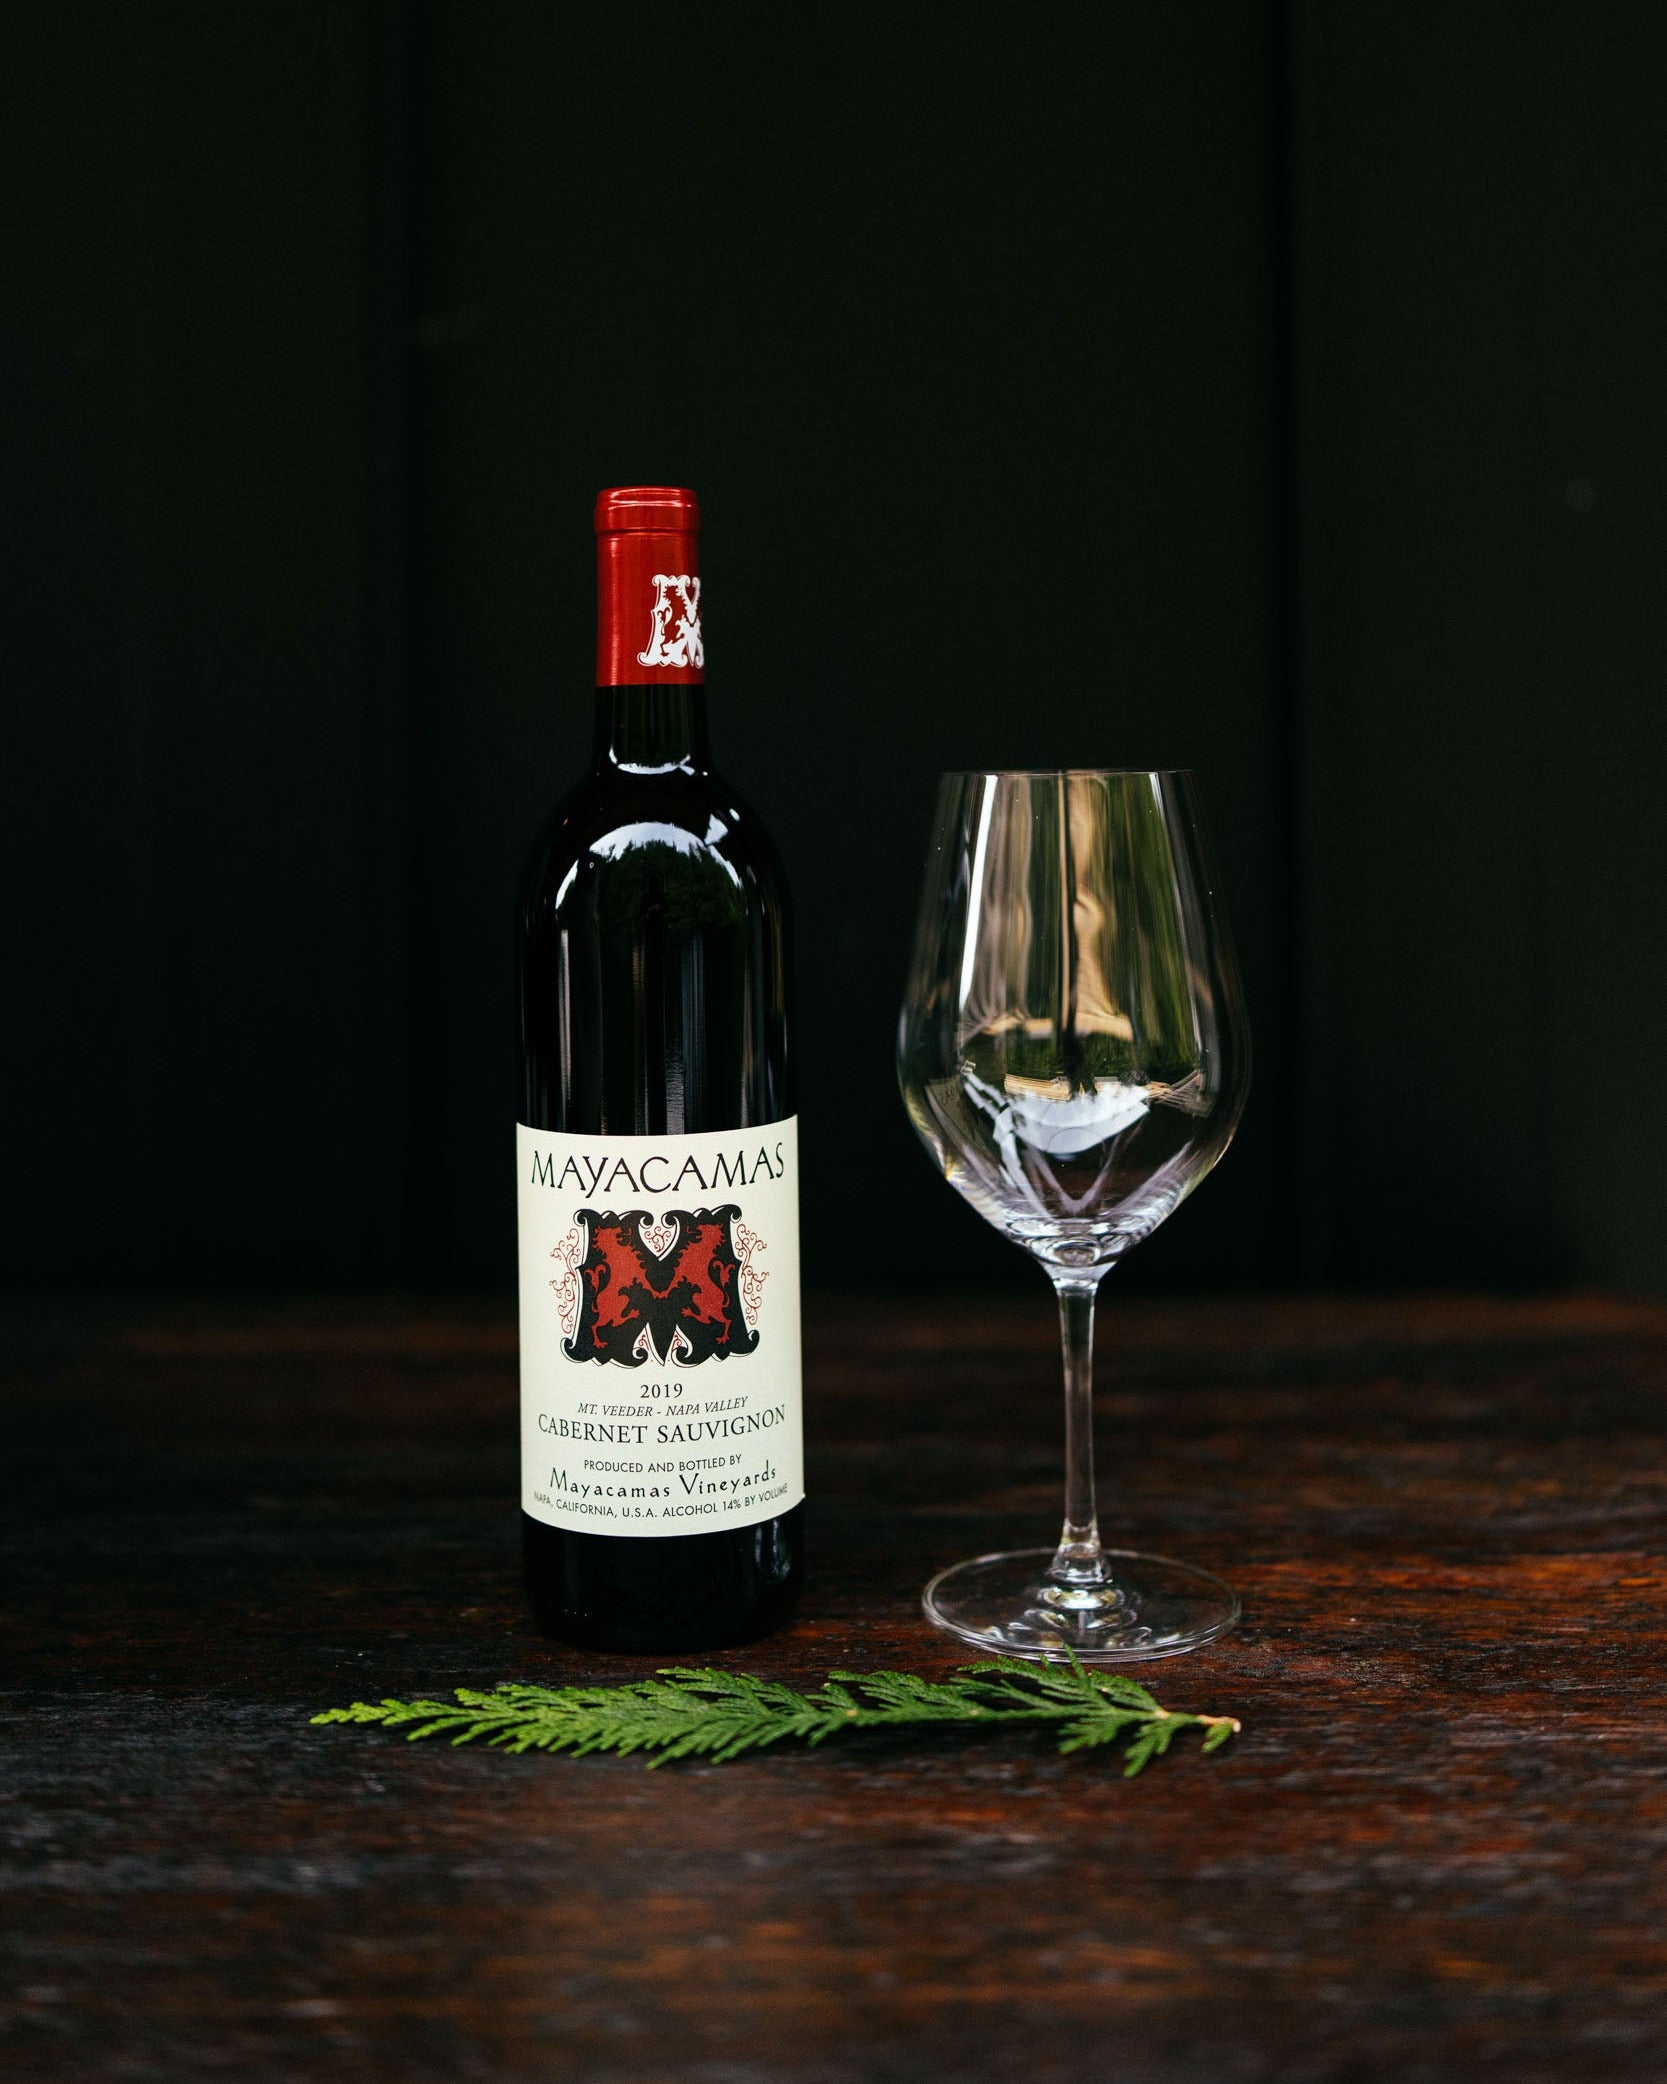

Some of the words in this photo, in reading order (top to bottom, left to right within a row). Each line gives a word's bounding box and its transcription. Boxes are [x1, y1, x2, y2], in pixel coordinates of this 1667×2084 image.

[531, 1142, 784, 1199] MAYACAMAS
[640, 1383, 683, 1398] 2019
[577, 1402, 598, 1415] MT.
[602, 1404, 653, 1417] VEEDER
[666, 1403, 700, 1417] NAPA
[704, 1396, 748, 1413] VALLEY
[538, 1413, 648, 1444] CABERNET
[657, 1404, 785, 1444] SAUVIGNON
[584, 1459, 644, 1473] PRODUCED
[647, 1462, 675, 1473] AND
[679, 1457, 726, 1472] BOTTLED
[729, 1453, 742, 1466] BY
[549, 1467, 670, 1498] Mayacamas
[679, 1459, 776, 1495] Vineyards
[556, 1498, 618, 1519] CALIFORNIA,
[622, 1507, 658, 1518] U.S.A.
[662, 1503, 718, 1518] ALCOHOL
[722, 1499, 742, 1511] 14%
[744, 1495, 756, 1507] BY
